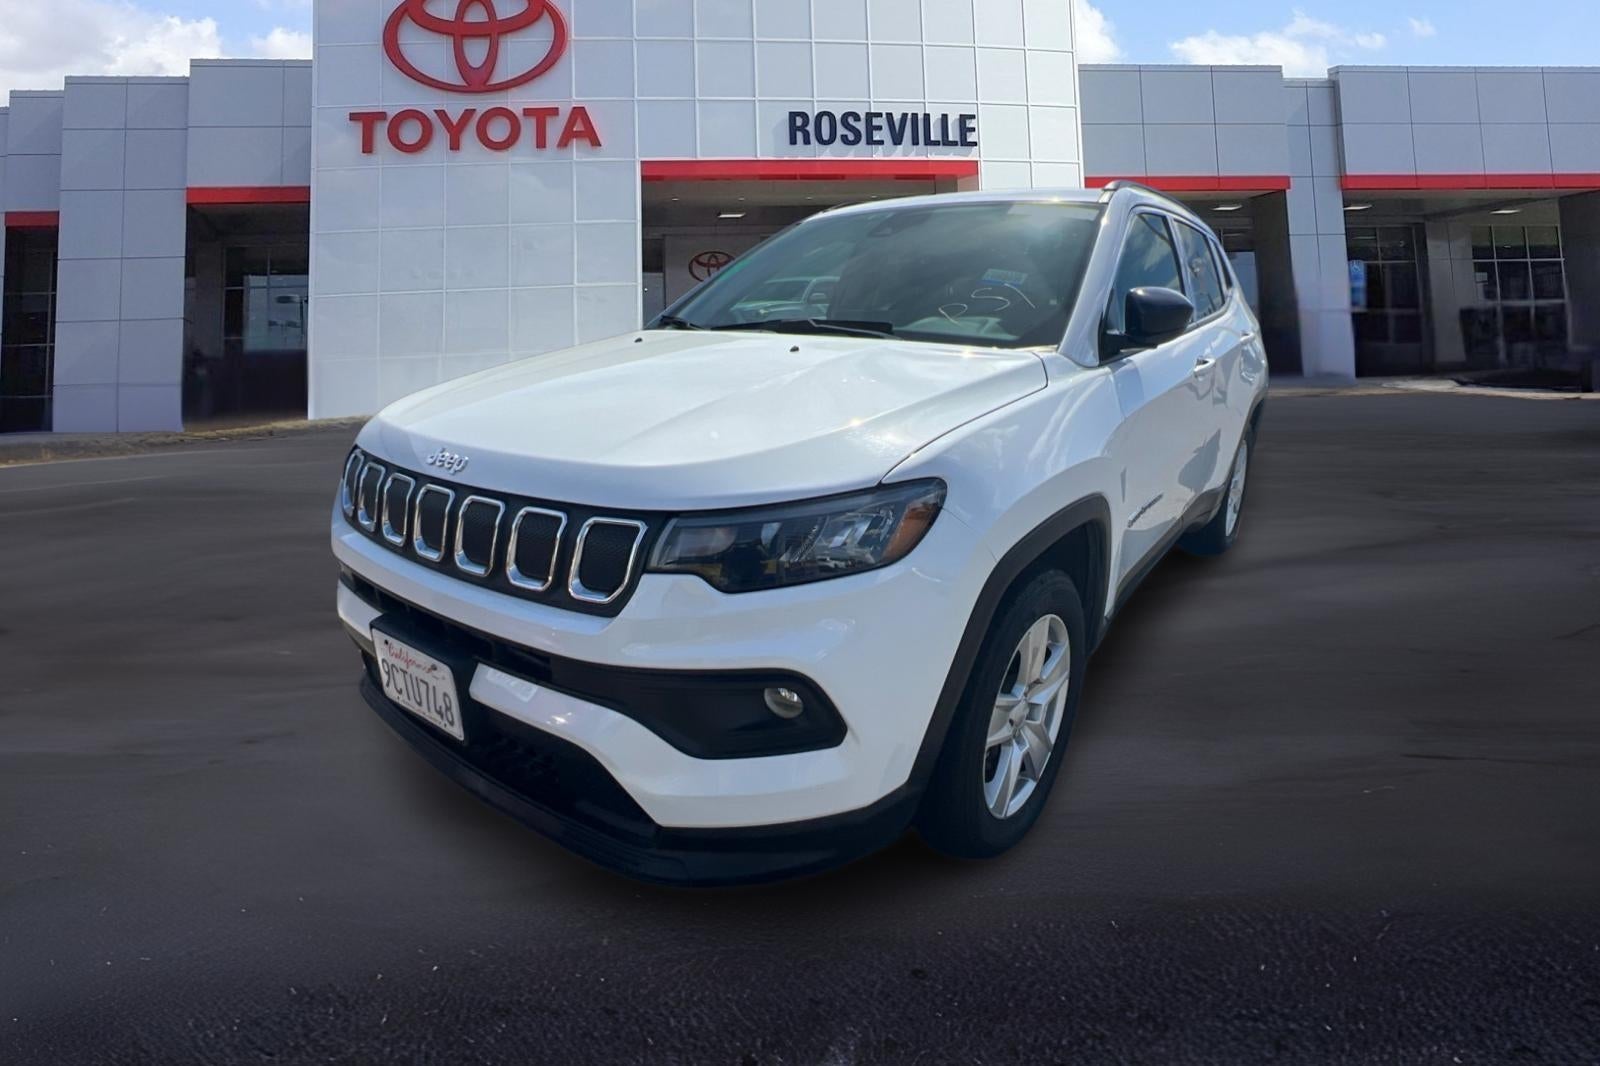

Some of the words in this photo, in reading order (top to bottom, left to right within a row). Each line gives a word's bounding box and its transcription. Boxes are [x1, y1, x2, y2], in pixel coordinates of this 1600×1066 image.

[349, 106, 602, 154] TOYOTA
[788, 111, 978, 147] ROSEVILLE
[427, 448, 469, 475] Jeep
[381, 658, 455, 727] 9CTU748
